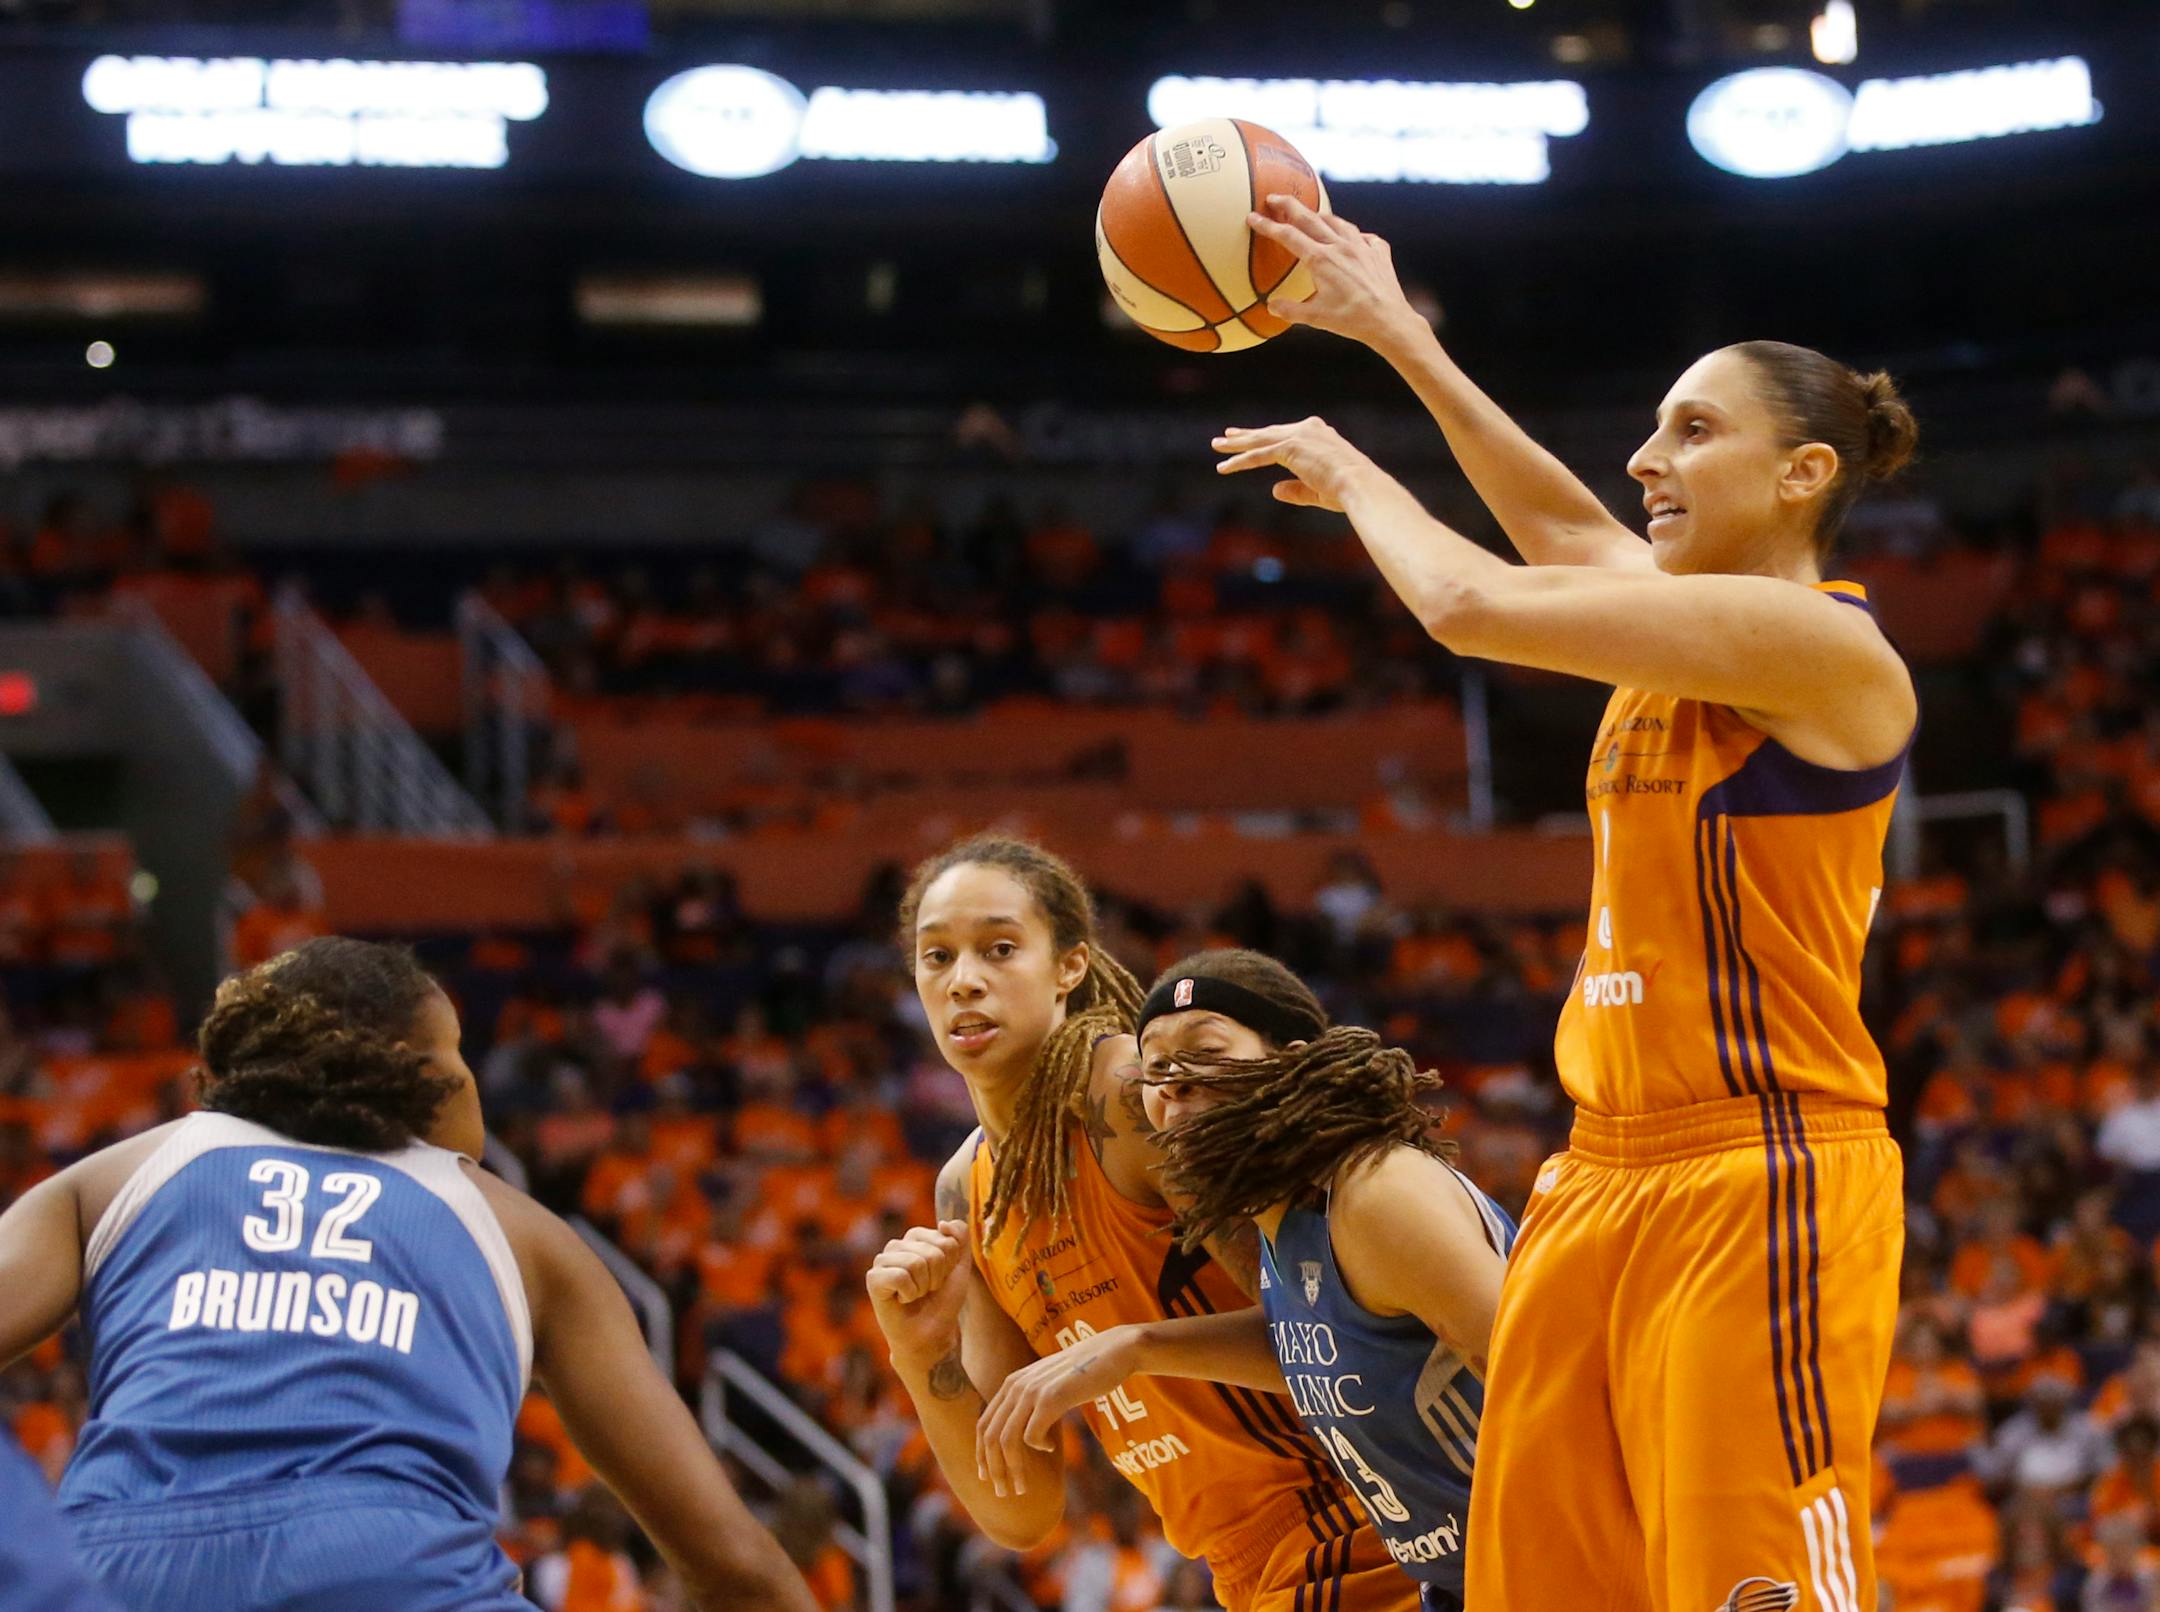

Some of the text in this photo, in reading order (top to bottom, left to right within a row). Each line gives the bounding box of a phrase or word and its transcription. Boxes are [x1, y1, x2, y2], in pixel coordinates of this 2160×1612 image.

[1624, 774, 1687, 795] RESORT
[243, 1158, 382, 1263] 32
[168, 1268, 420, 1355] BRUNSON
[1067, 1277, 1120, 1306] RESORT
[1285, 1373, 1376, 1418] LINIC
[1111, 1433, 1190, 1475] verizon
